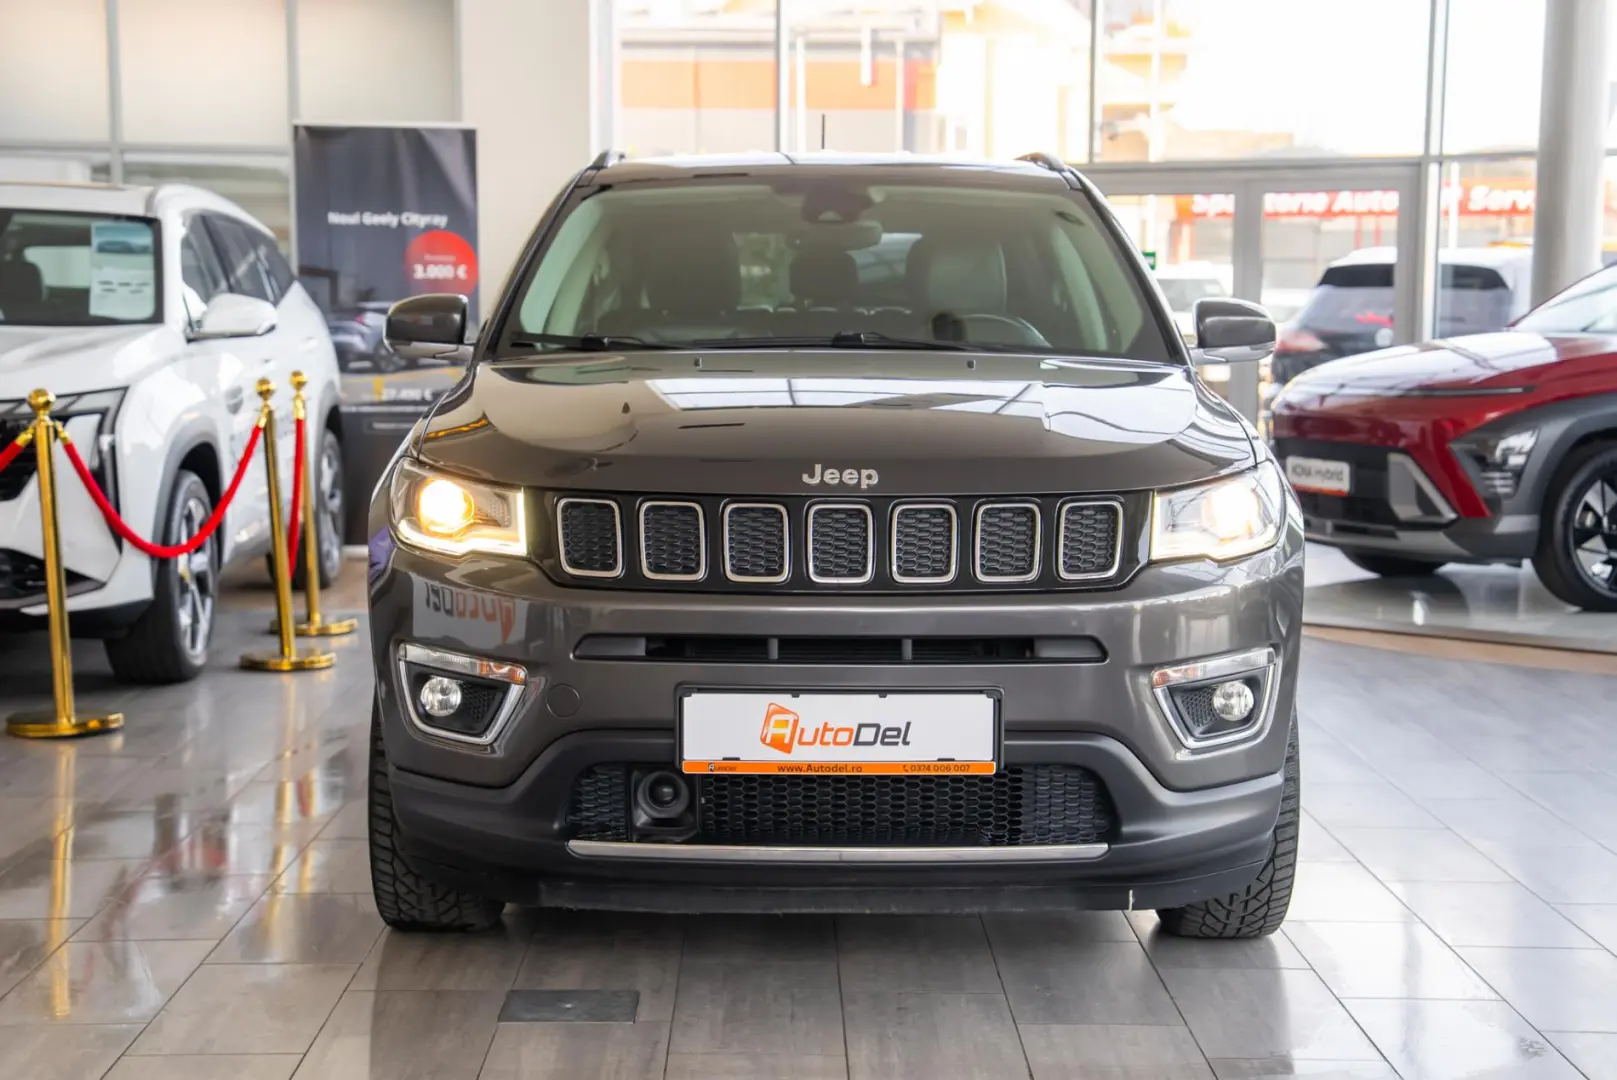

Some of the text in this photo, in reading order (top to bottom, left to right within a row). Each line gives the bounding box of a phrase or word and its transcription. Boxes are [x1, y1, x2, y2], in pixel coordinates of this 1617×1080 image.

[362, 211, 399, 228] Geely
[400, 211, 448, 229] Cityray
[802, 463, 879, 489] Jeep
[763, 709, 912, 750] AutoDel
[777, 763, 862, 773] www.Autodel.ro
[910, 764, 970, 773] 0374 006 007
